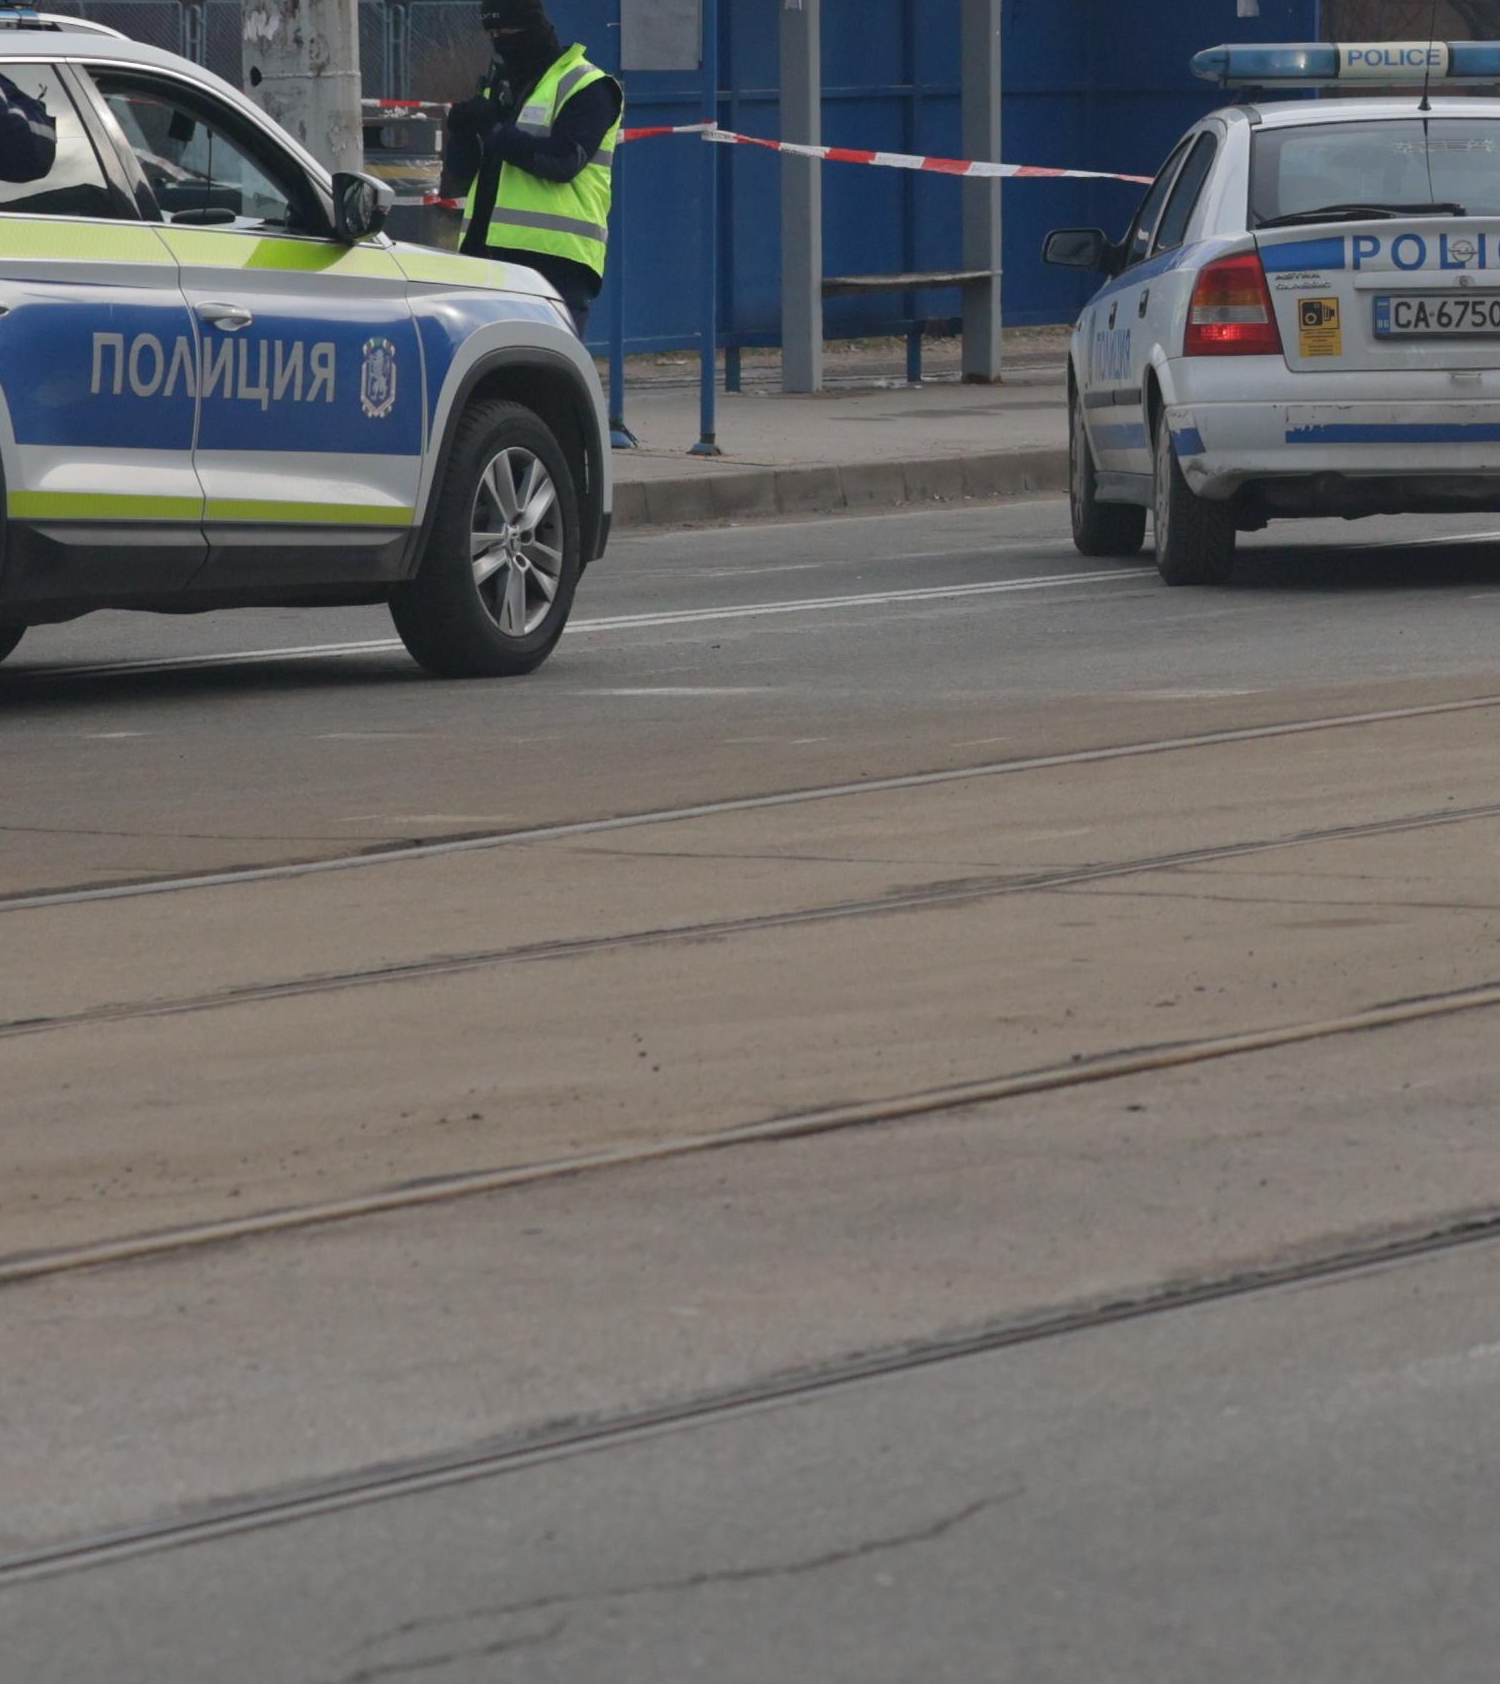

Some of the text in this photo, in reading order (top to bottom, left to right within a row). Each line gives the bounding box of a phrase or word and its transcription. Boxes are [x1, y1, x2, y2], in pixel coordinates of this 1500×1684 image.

[1347, 48, 1442, 67] POLICE
[1394, 301, 1430, 329] CA
[90, 331, 336, 412] ПОЛИЦИЯ
[1096, 328, 1131, 382] ПОЛИЦИЯ
